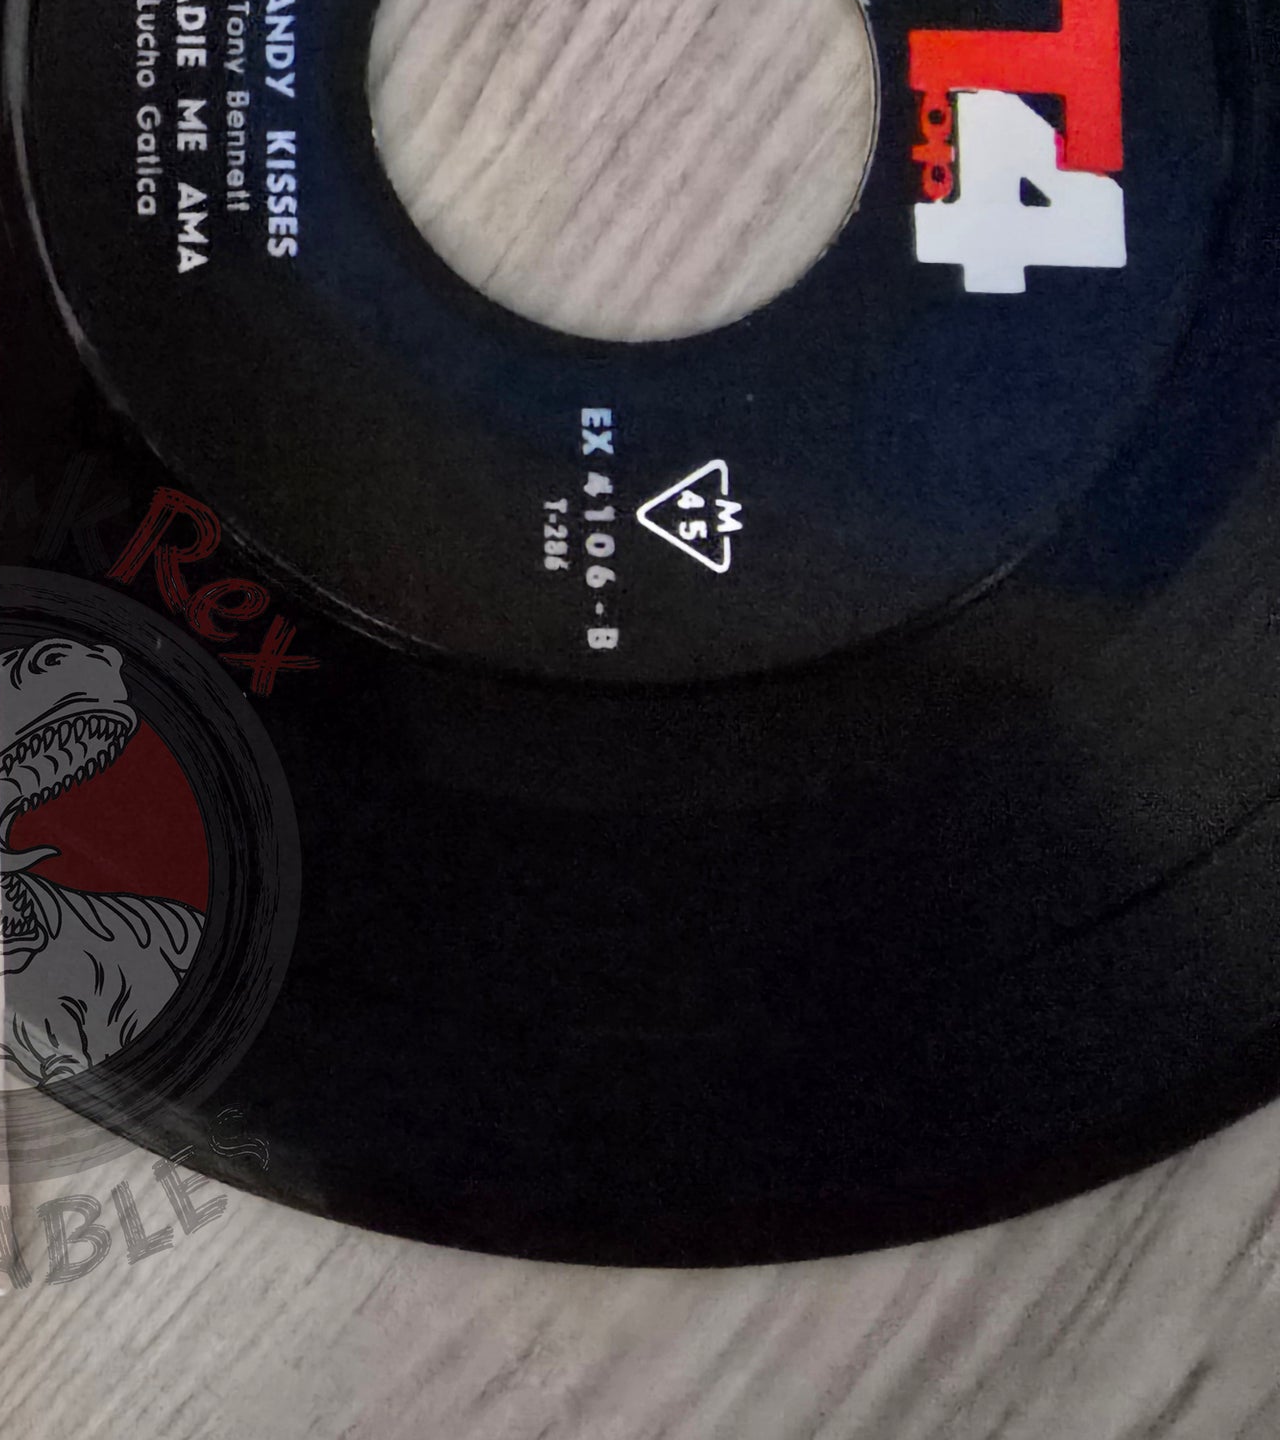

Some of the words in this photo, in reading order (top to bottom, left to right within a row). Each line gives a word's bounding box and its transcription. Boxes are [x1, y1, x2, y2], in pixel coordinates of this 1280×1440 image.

[137, 0, 160, 87] Lucho
[225, 1, 250, 73] Tony
[137, 106, 160, 214] Gatica
[177, 100, 207, 150] ME
[227, 91, 250, 210] Bennett
[178, 183, 208, 272] AMA
[266, 131, 298, 256] KISSES
[582, 408, 613, 454] EX
